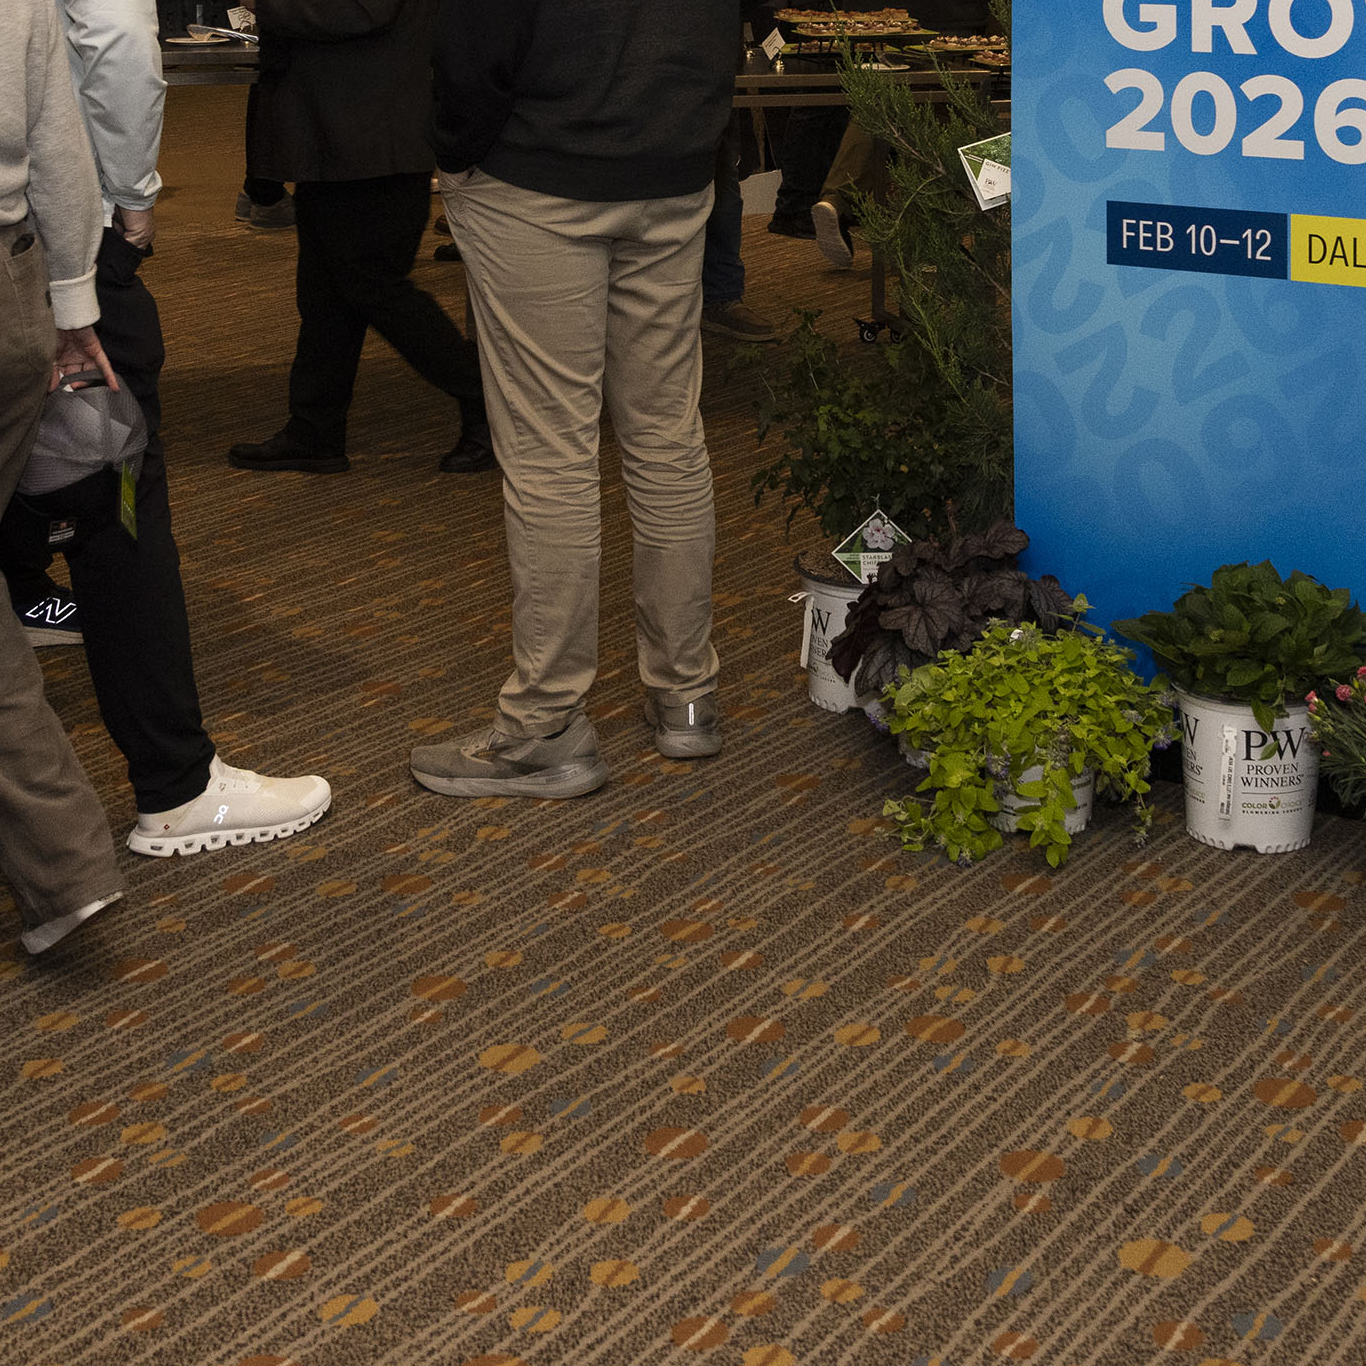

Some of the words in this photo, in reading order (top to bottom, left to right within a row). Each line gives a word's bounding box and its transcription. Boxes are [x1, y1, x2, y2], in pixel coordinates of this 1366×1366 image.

[1121, 219, 1174, 253] FEB
[811, 607, 832, 635] W
[1240, 726, 1307, 762] PW
[1246, 762, 1300, 776] PROVEN
[1242, 802, 1268, 810] COLOR
